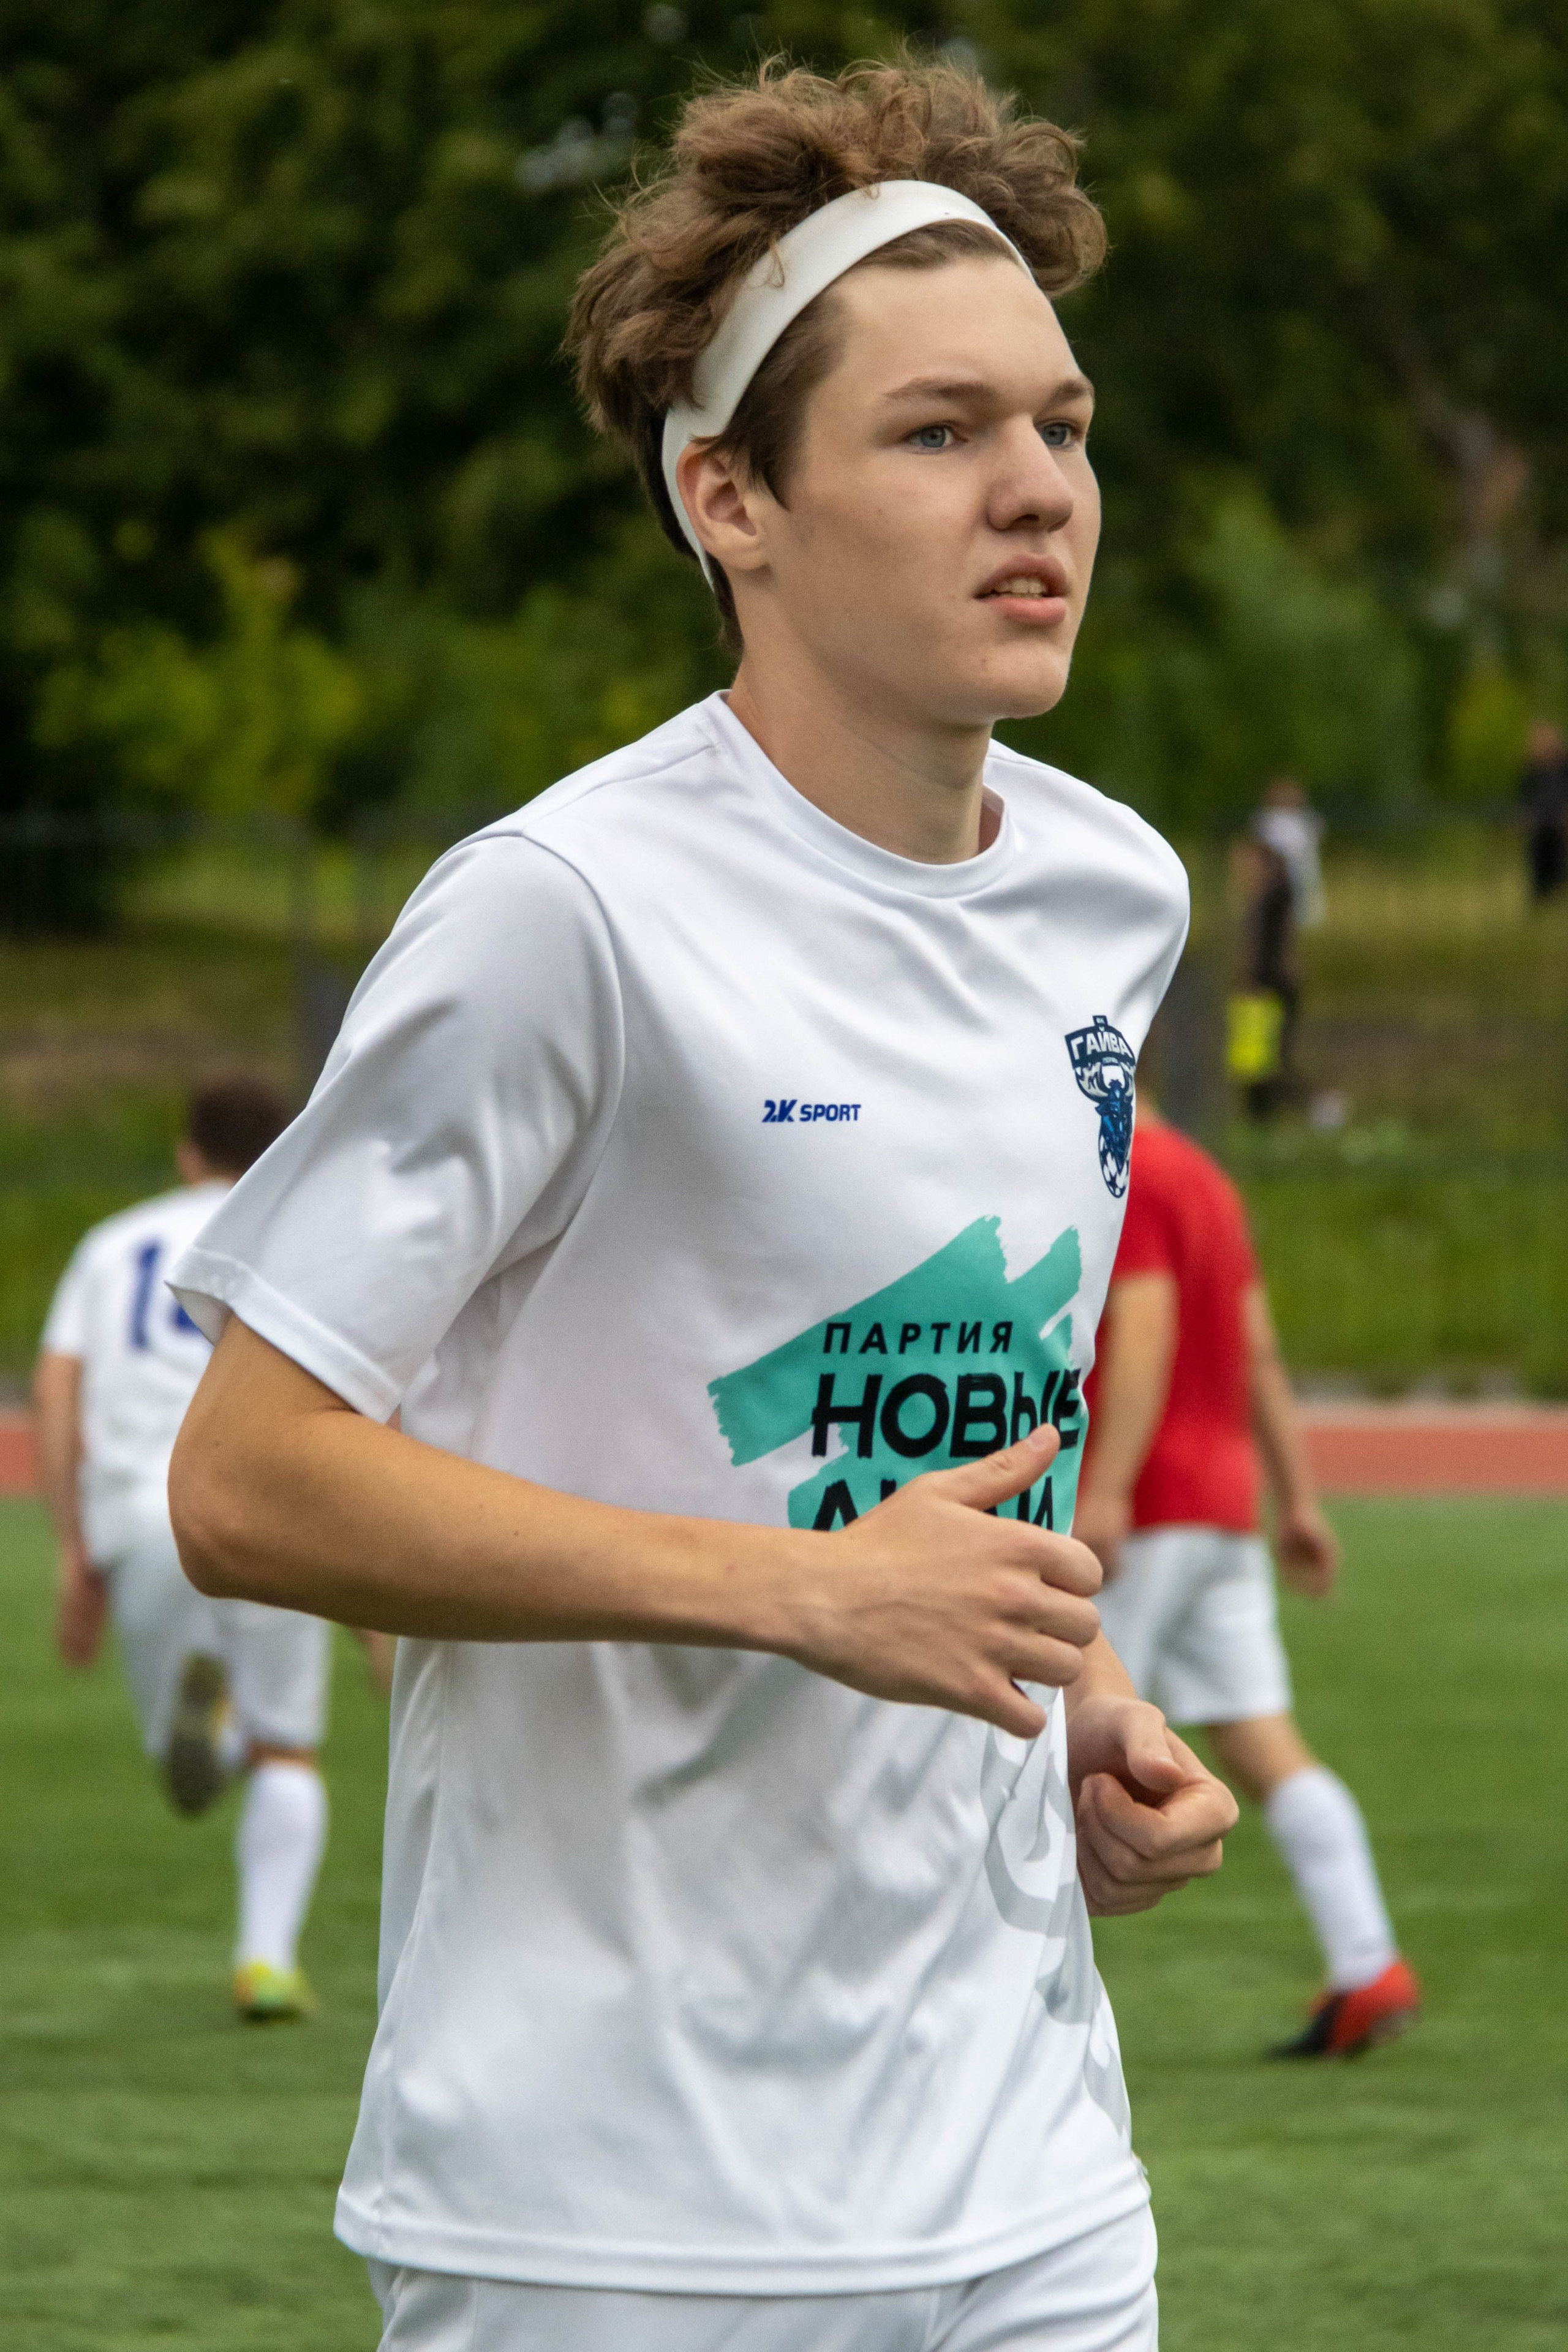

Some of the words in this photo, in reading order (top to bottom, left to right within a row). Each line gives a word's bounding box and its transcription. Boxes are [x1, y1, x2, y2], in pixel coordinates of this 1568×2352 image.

[762, 1099, 797, 1123] 2K
[799, 1104, 861, 1121] SPORT
[823, 1321, 1014, 1355] ПАРТИЯ
[811, 1368, 1082, 1458] НОВЫЕ
